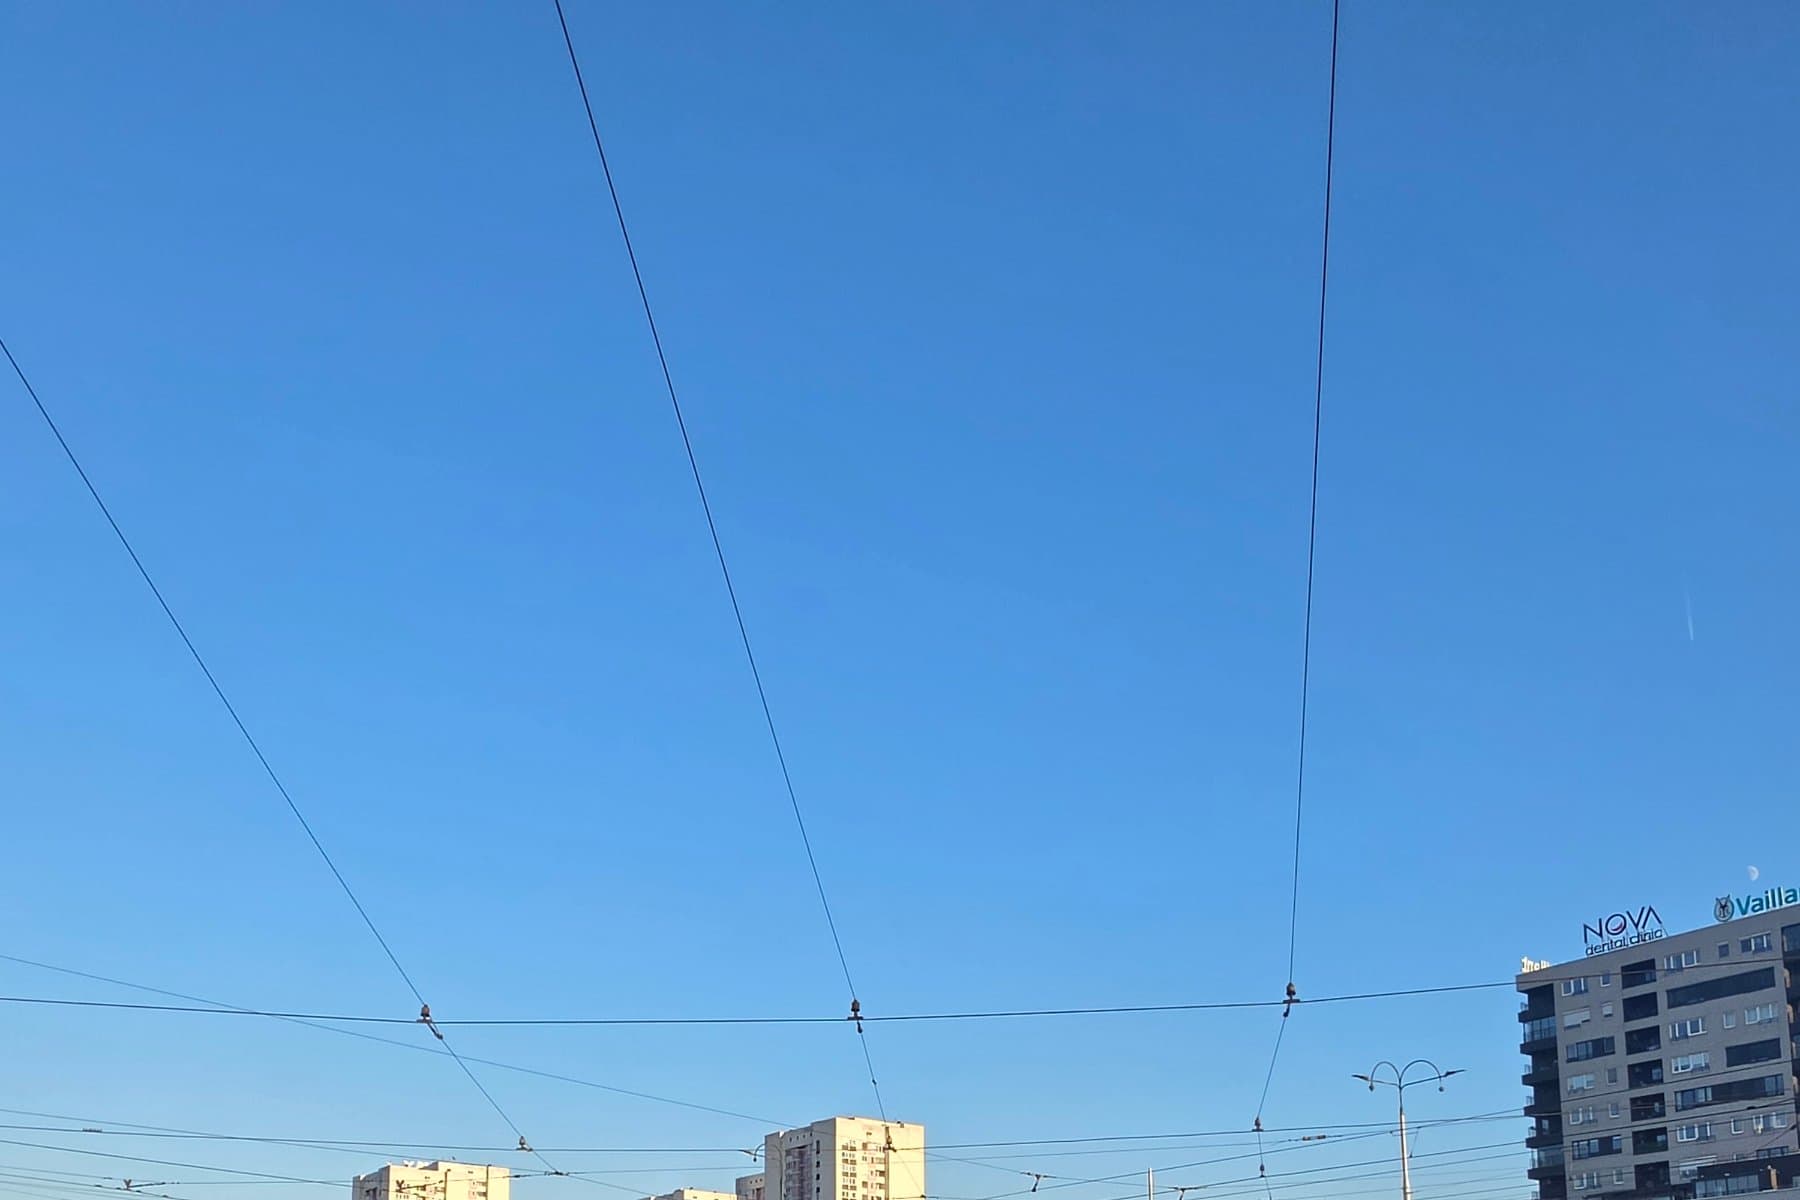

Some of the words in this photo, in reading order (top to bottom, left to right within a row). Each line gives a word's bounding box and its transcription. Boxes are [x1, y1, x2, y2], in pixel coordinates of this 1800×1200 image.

[1736, 886, 1800, 916] Vailla
[1583, 904, 1663, 945] NOVA
[1585, 935, 1628, 956] dental
[1629, 928, 1664, 945] clinic
